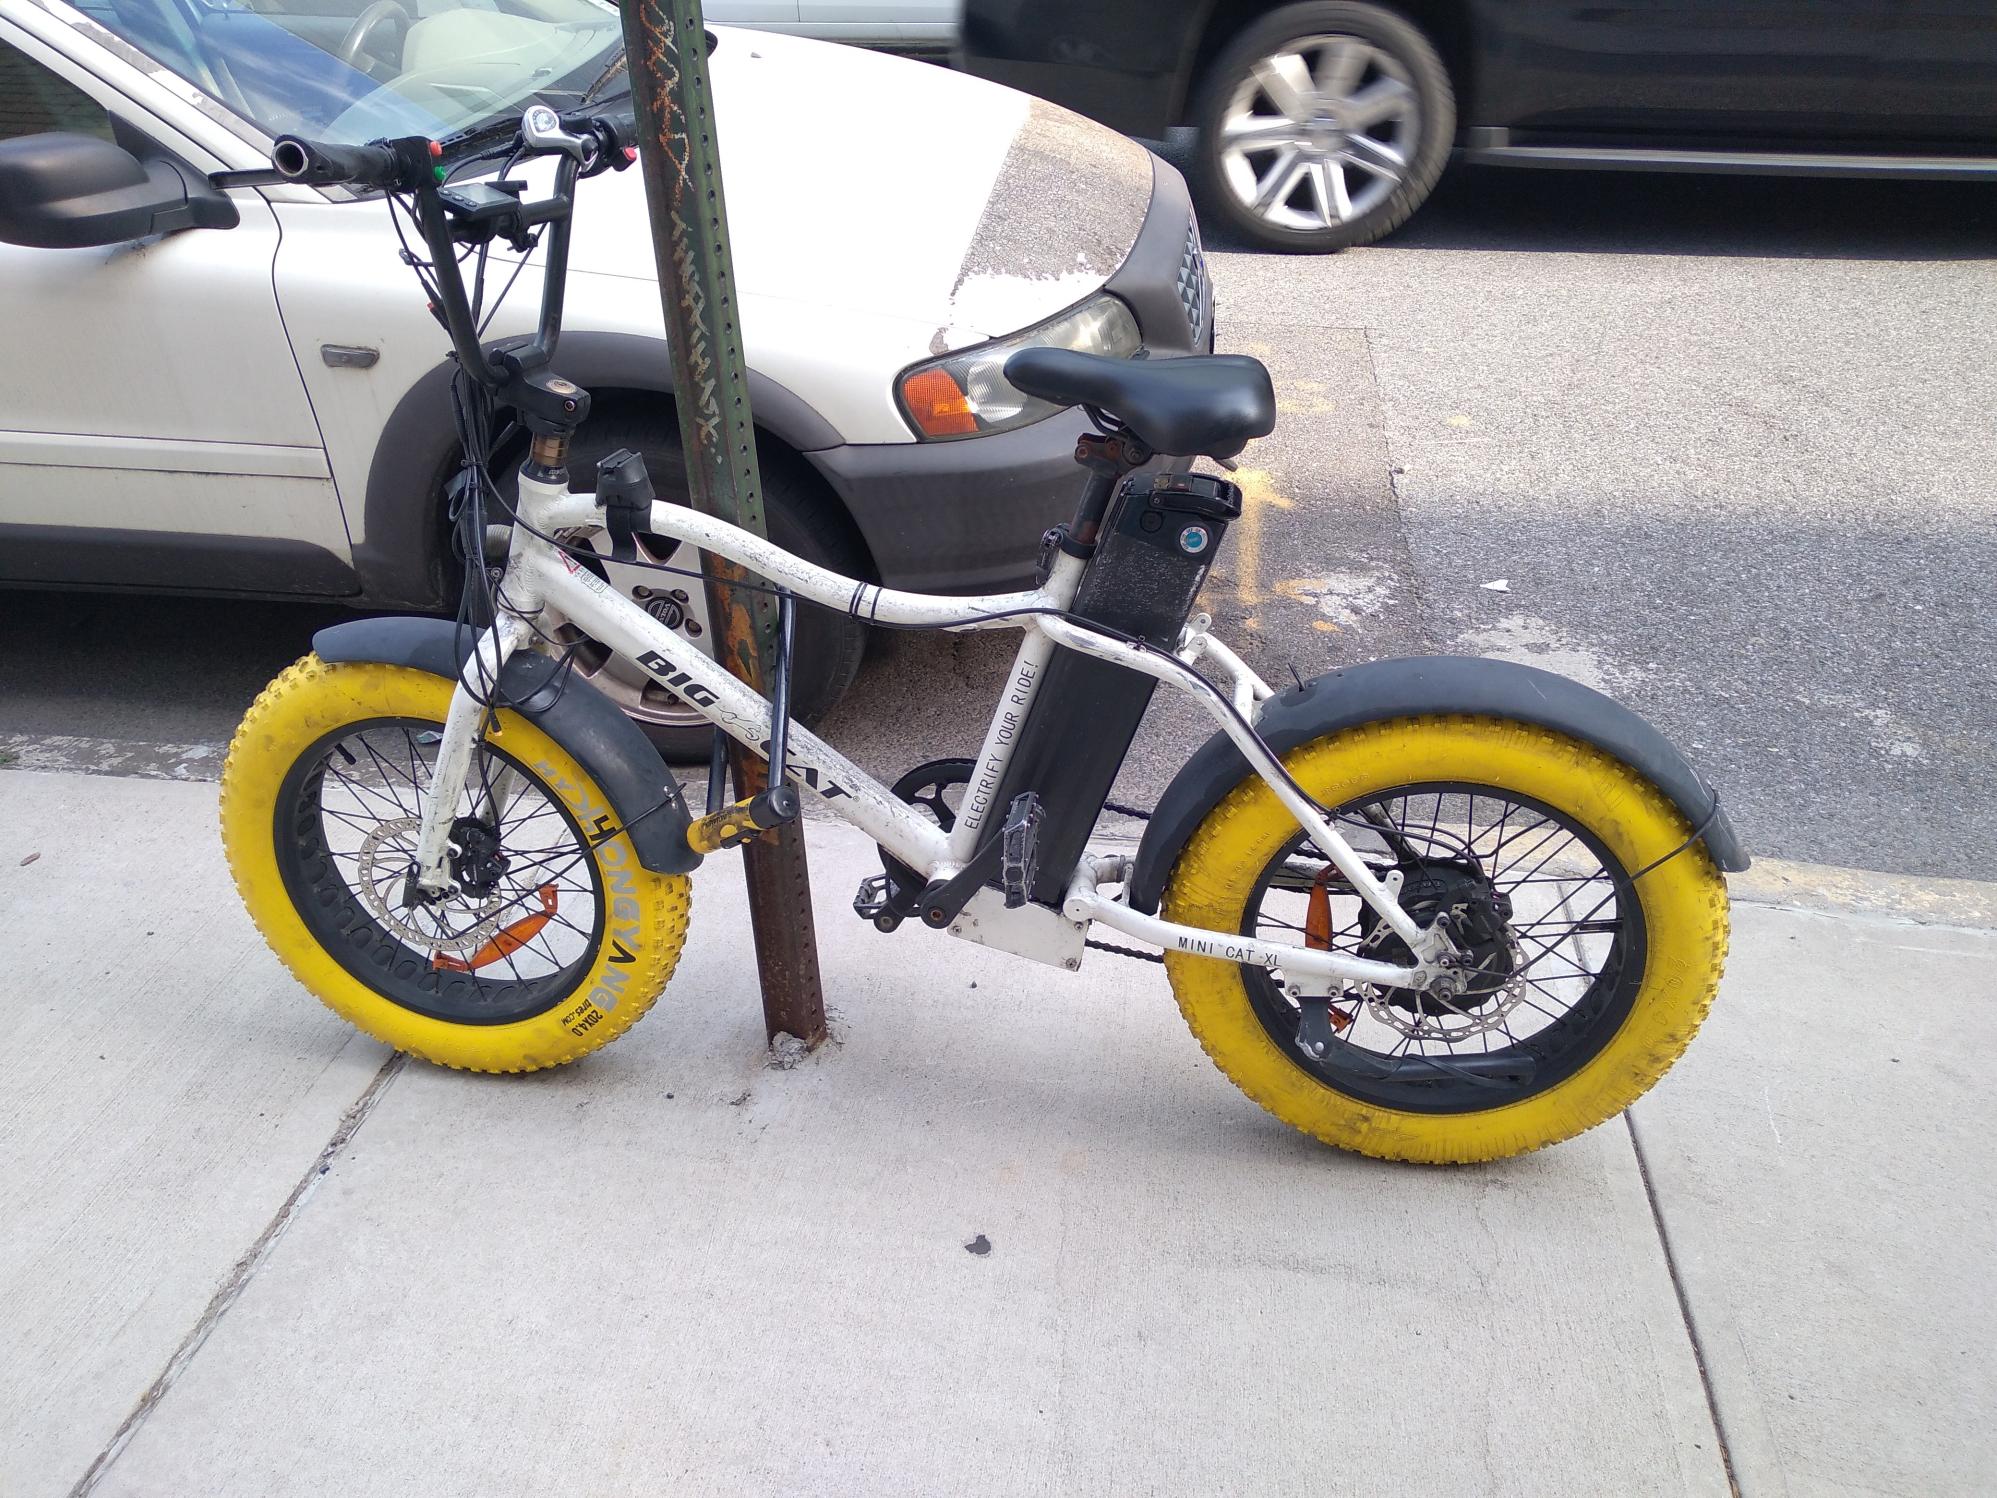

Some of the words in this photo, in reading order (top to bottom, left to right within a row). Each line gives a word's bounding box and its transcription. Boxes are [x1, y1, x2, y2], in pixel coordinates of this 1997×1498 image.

[636, 650, 720, 708] BIG
[965, 753, 1003, 830] ELECTRIFY
[995, 711, 1020, 746] YOUR
[1011, 660, 1039, 706] RIDE!
[1178, 936, 1214, 954] MINI
[1225, 946, 1255, 961] CAT
[1264, 952, 1282, 967] XL
[571, 1009, 604, 1037] 20X4.0
